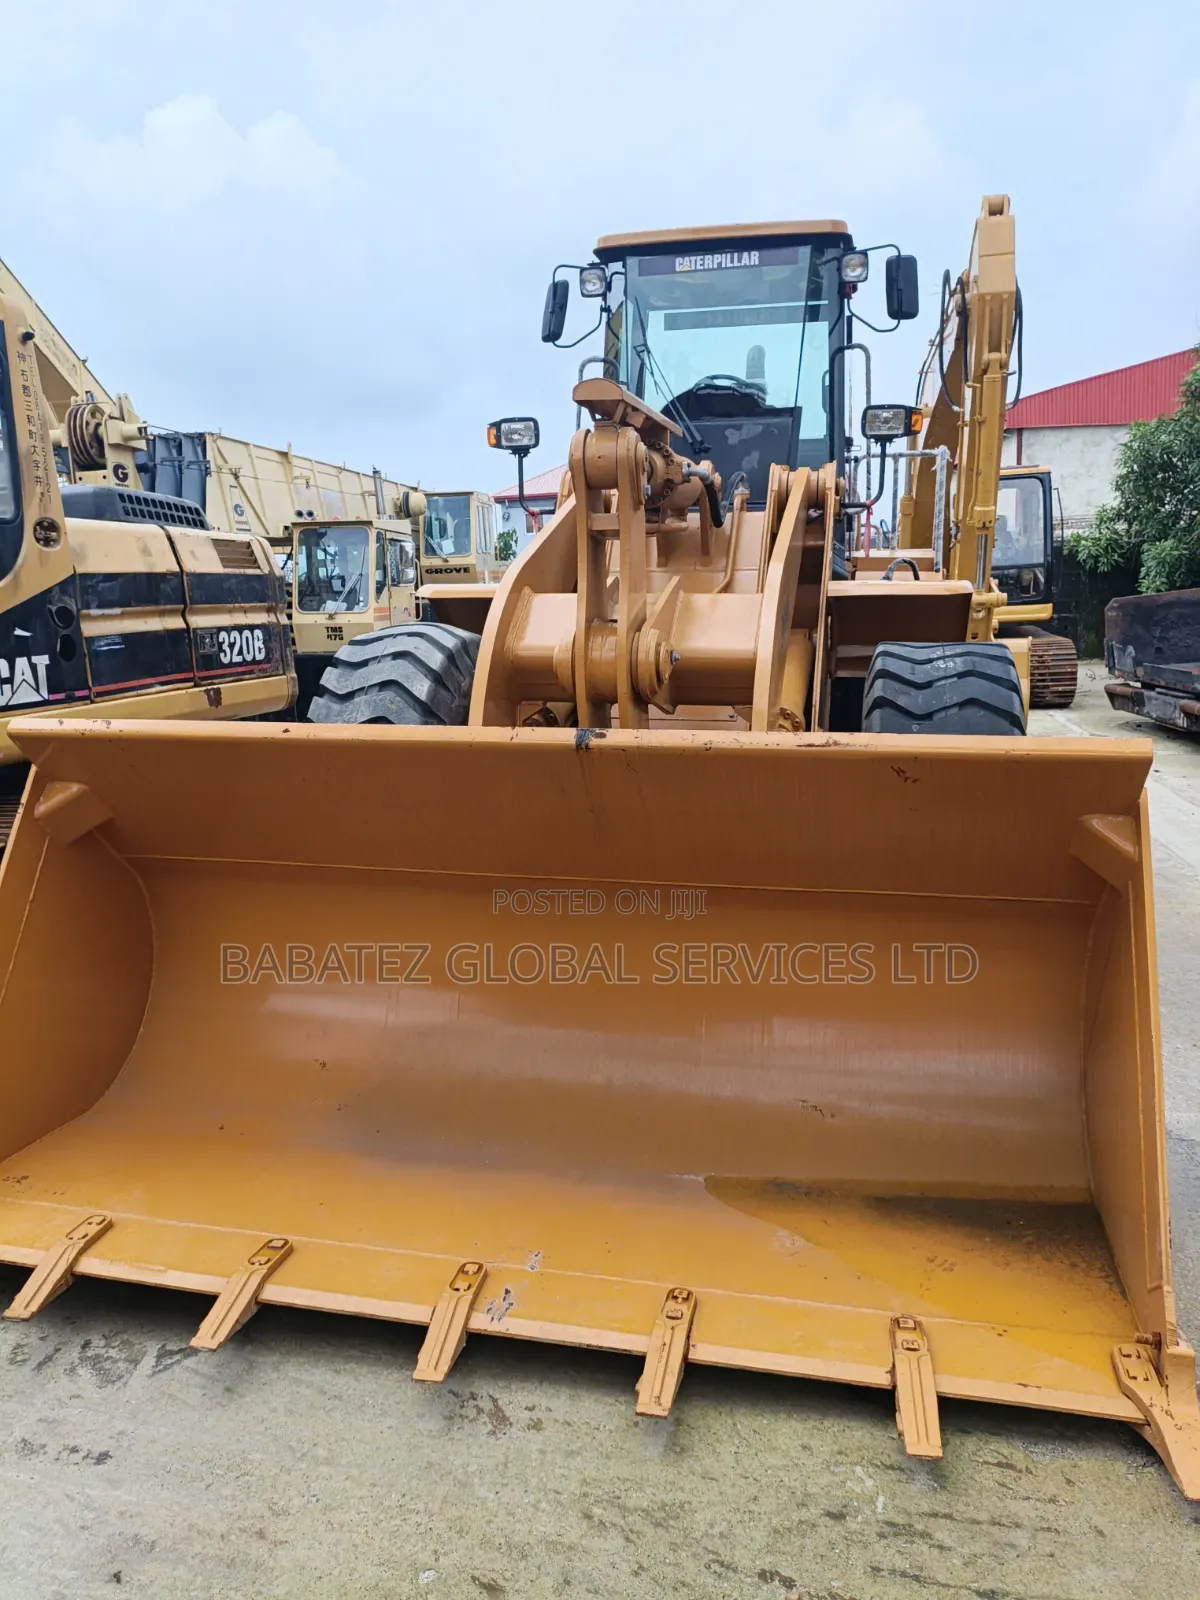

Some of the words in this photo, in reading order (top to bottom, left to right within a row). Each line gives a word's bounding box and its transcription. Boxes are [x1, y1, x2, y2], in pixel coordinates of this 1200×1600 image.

[675, 251, 759, 272] CATERPILLAR
[16, 350, 45, 503] 神石郡三和町大字井
[425, 566, 471, 575] GROVE
[324, 626, 343, 634] TMS
[218, 628, 266, 664] 320B
[0, 655, 50, 707] CAT
